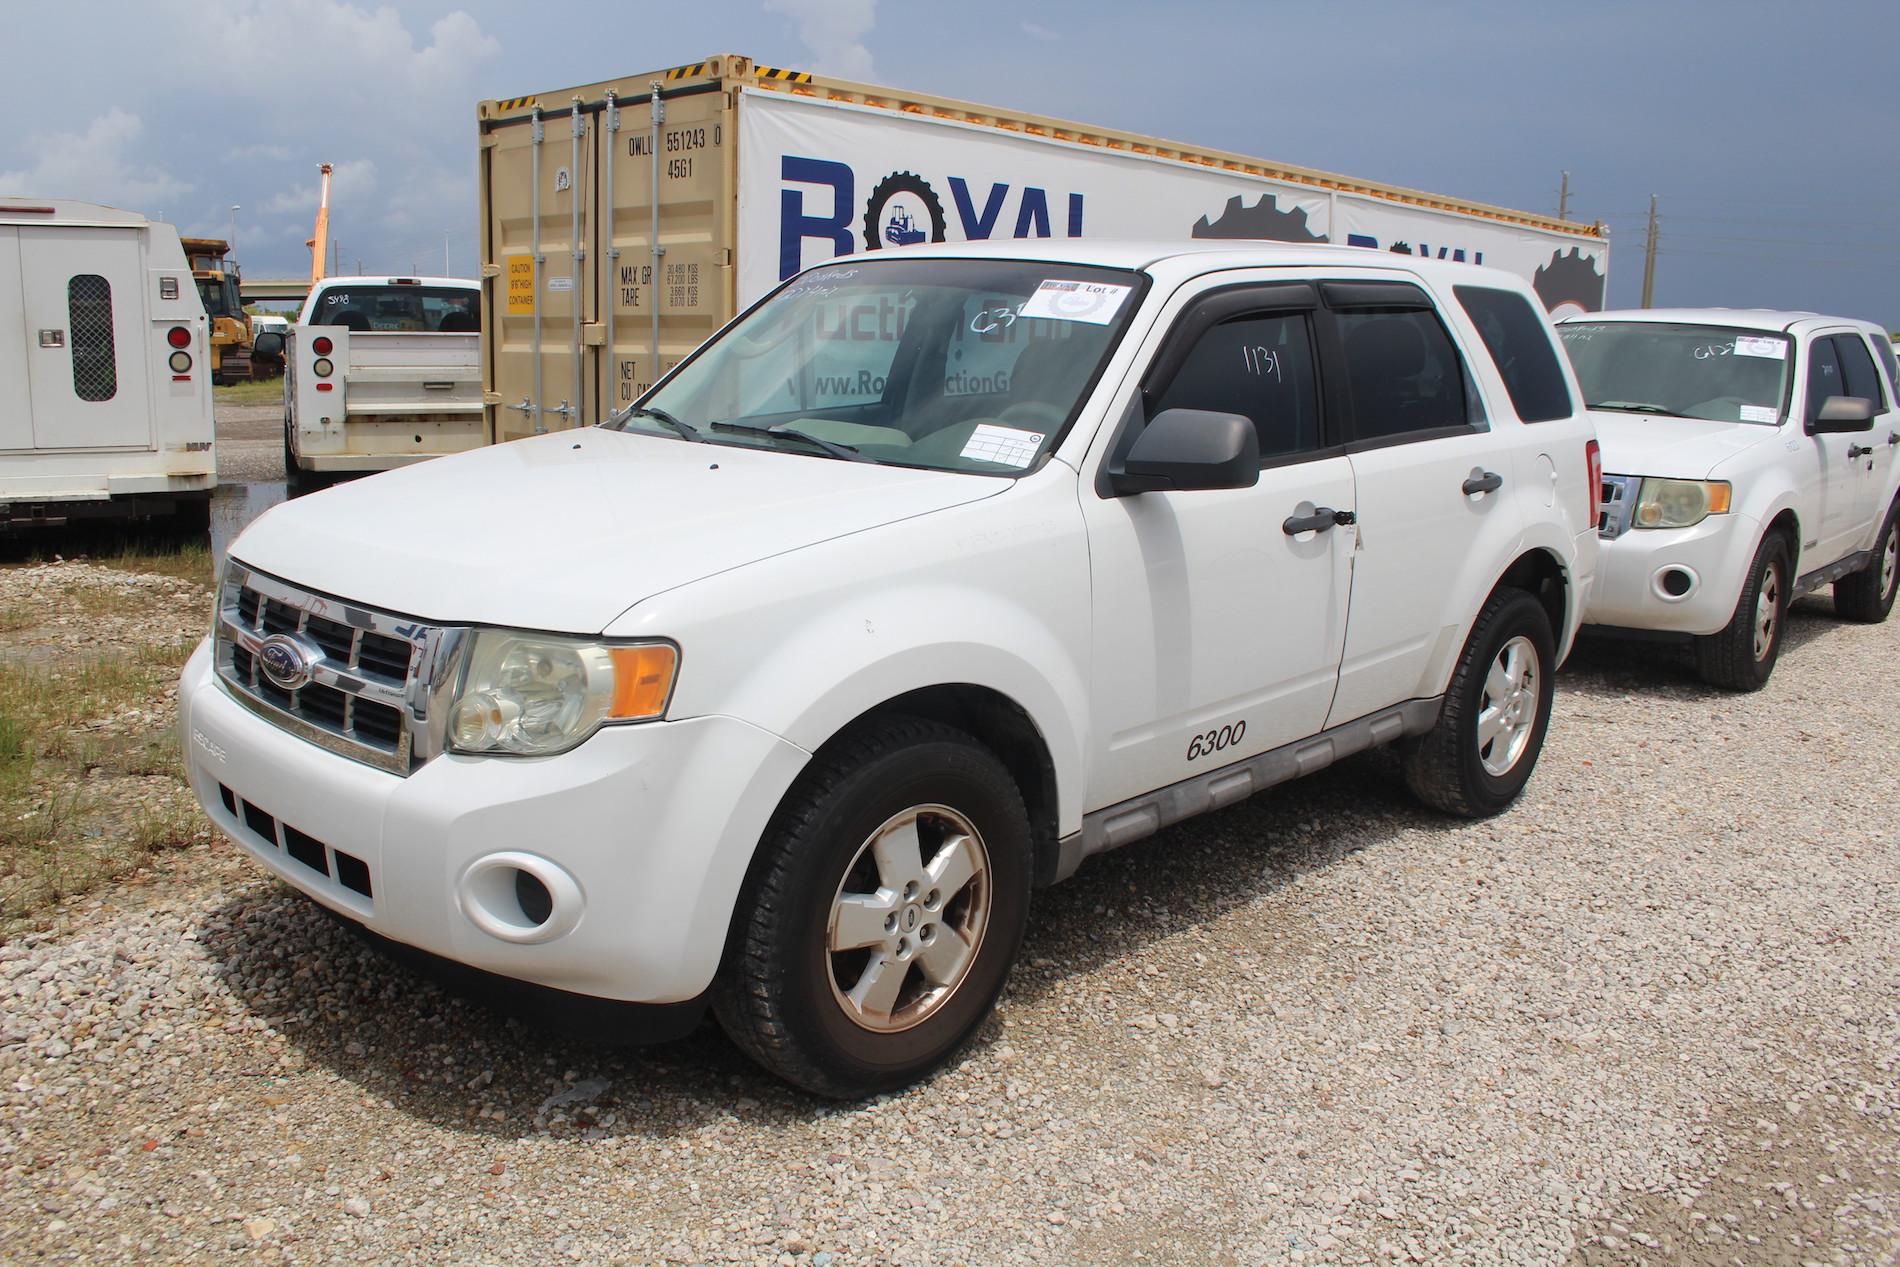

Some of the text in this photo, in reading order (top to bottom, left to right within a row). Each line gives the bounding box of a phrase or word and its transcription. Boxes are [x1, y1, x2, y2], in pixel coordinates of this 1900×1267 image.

[628, 126, 721, 156] OWLU 551243 0
[668, 158, 692, 179] 45G1
[511, 263, 531, 273] CAUTION
[687, 264, 698, 274] KGS
[687, 274, 698, 285] LBS
[687, 286, 698, 297] KGS
[1085, 284, 1106, 294] Lot
[508, 295, 534, 305] CONTAINER
[621, 288, 640, 307] TARE
[687, 297, 698, 307] LBS
[1243, 345, 1281, 383] 1131
[621, 361, 636, 380] NET
[1186, 720, 1246, 761] 6300
